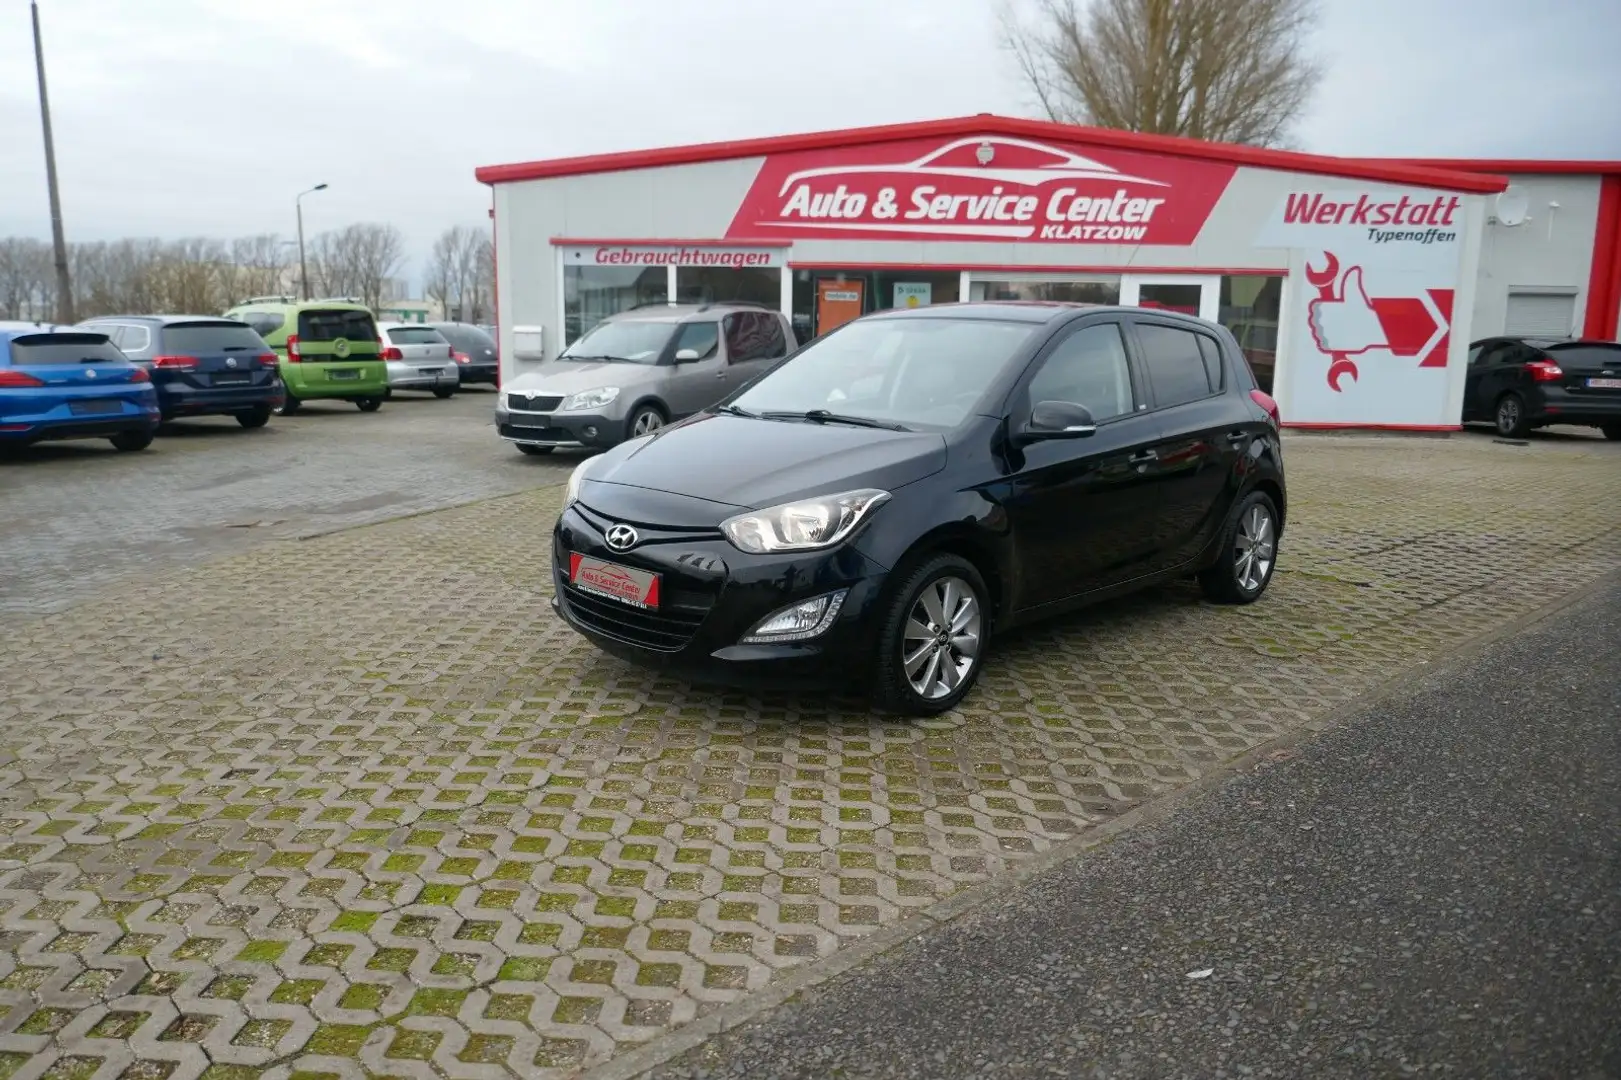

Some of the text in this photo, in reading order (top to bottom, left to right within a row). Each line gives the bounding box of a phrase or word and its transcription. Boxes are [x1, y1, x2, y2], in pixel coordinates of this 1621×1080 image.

[781, 185, 1165, 223] Auto & Service Center
[1284, 193, 1460, 226] Werkstatt
[1040, 225, 1147, 241] KLATZOW
[1367, 228, 1456, 244] Typenoffen
[595, 247, 770, 270] Gebrauchtwagen
[581, 570, 594, 581] Auto
[599, 574, 620, 588] Service
[621, 581, 640, 593] Center
